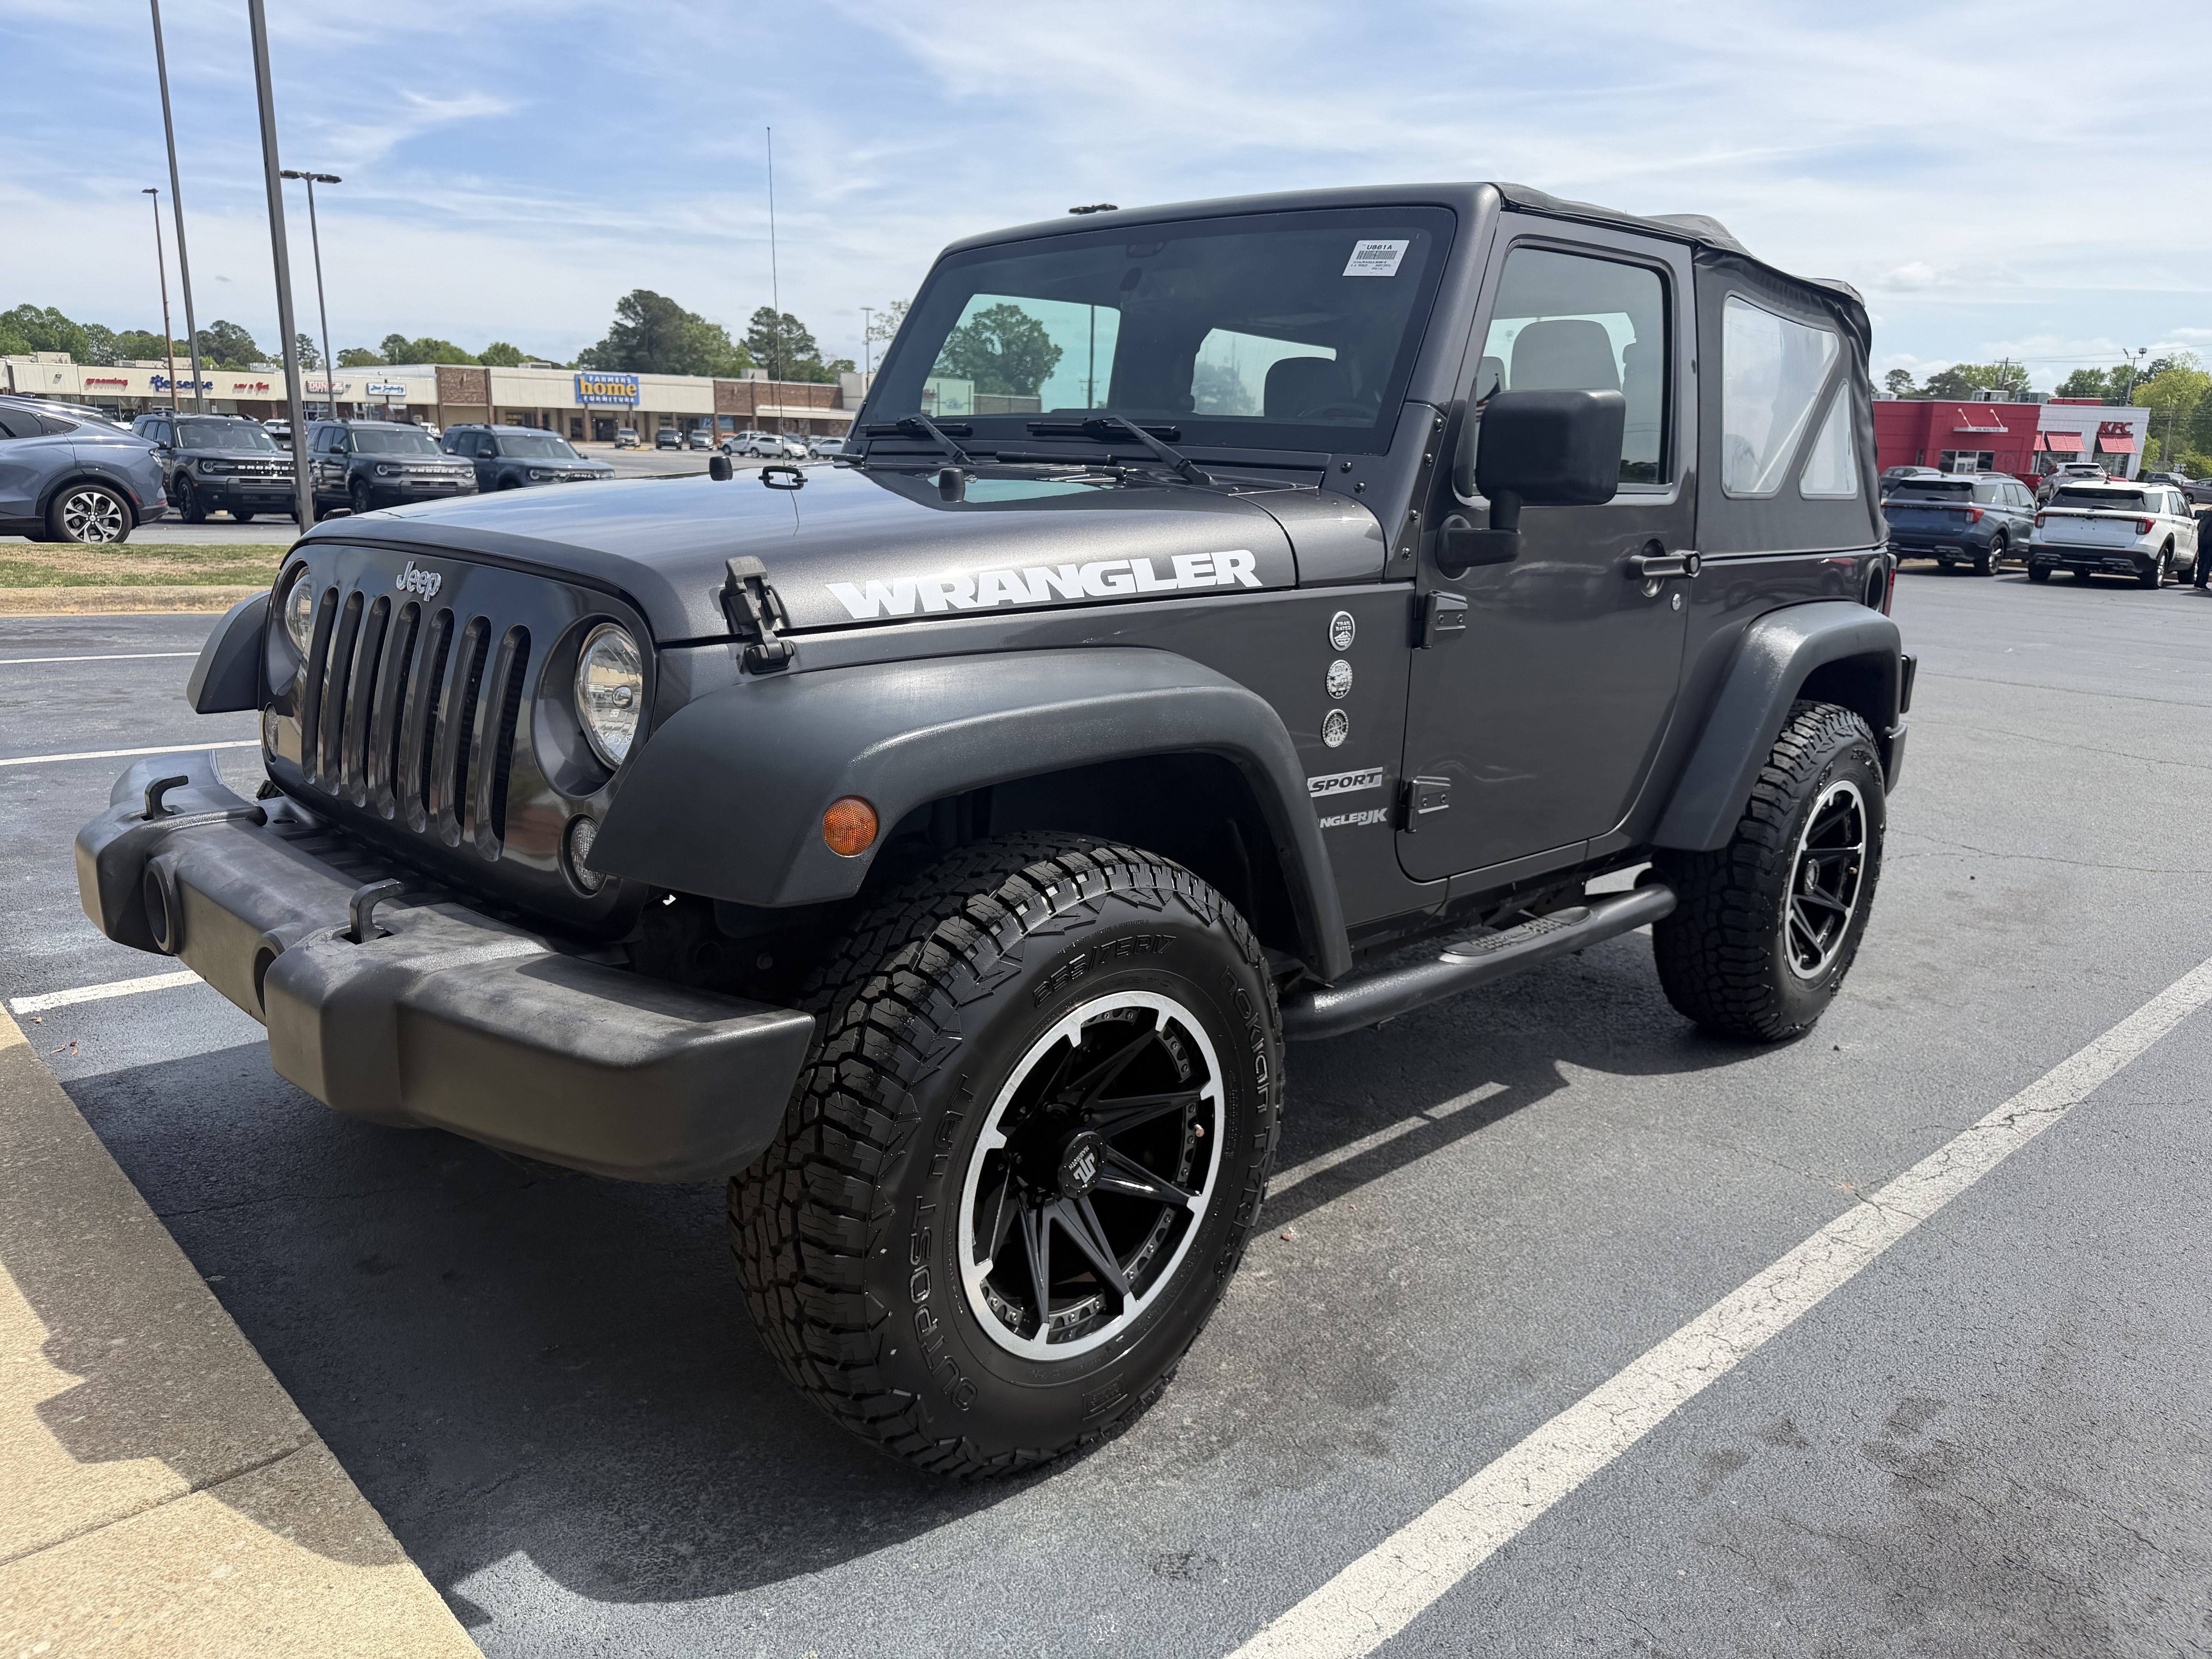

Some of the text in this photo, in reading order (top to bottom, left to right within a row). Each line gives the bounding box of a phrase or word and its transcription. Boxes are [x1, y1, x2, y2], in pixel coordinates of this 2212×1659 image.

[579, 376, 637, 397] home
[2099, 421, 2133, 434] KFC
[396, 561, 442, 602] Jeep
[825, 549, 1263, 619] WRANGLER
[1310, 773, 1379, 793] SPORT
[1318, 812, 1367, 828] NGLER
[1033, 934, 1177, 1008] 255/75R17
[1213, 1126, 1271, 1279] TYRES
[910, 1195, 978, 1411] OUTPOST
